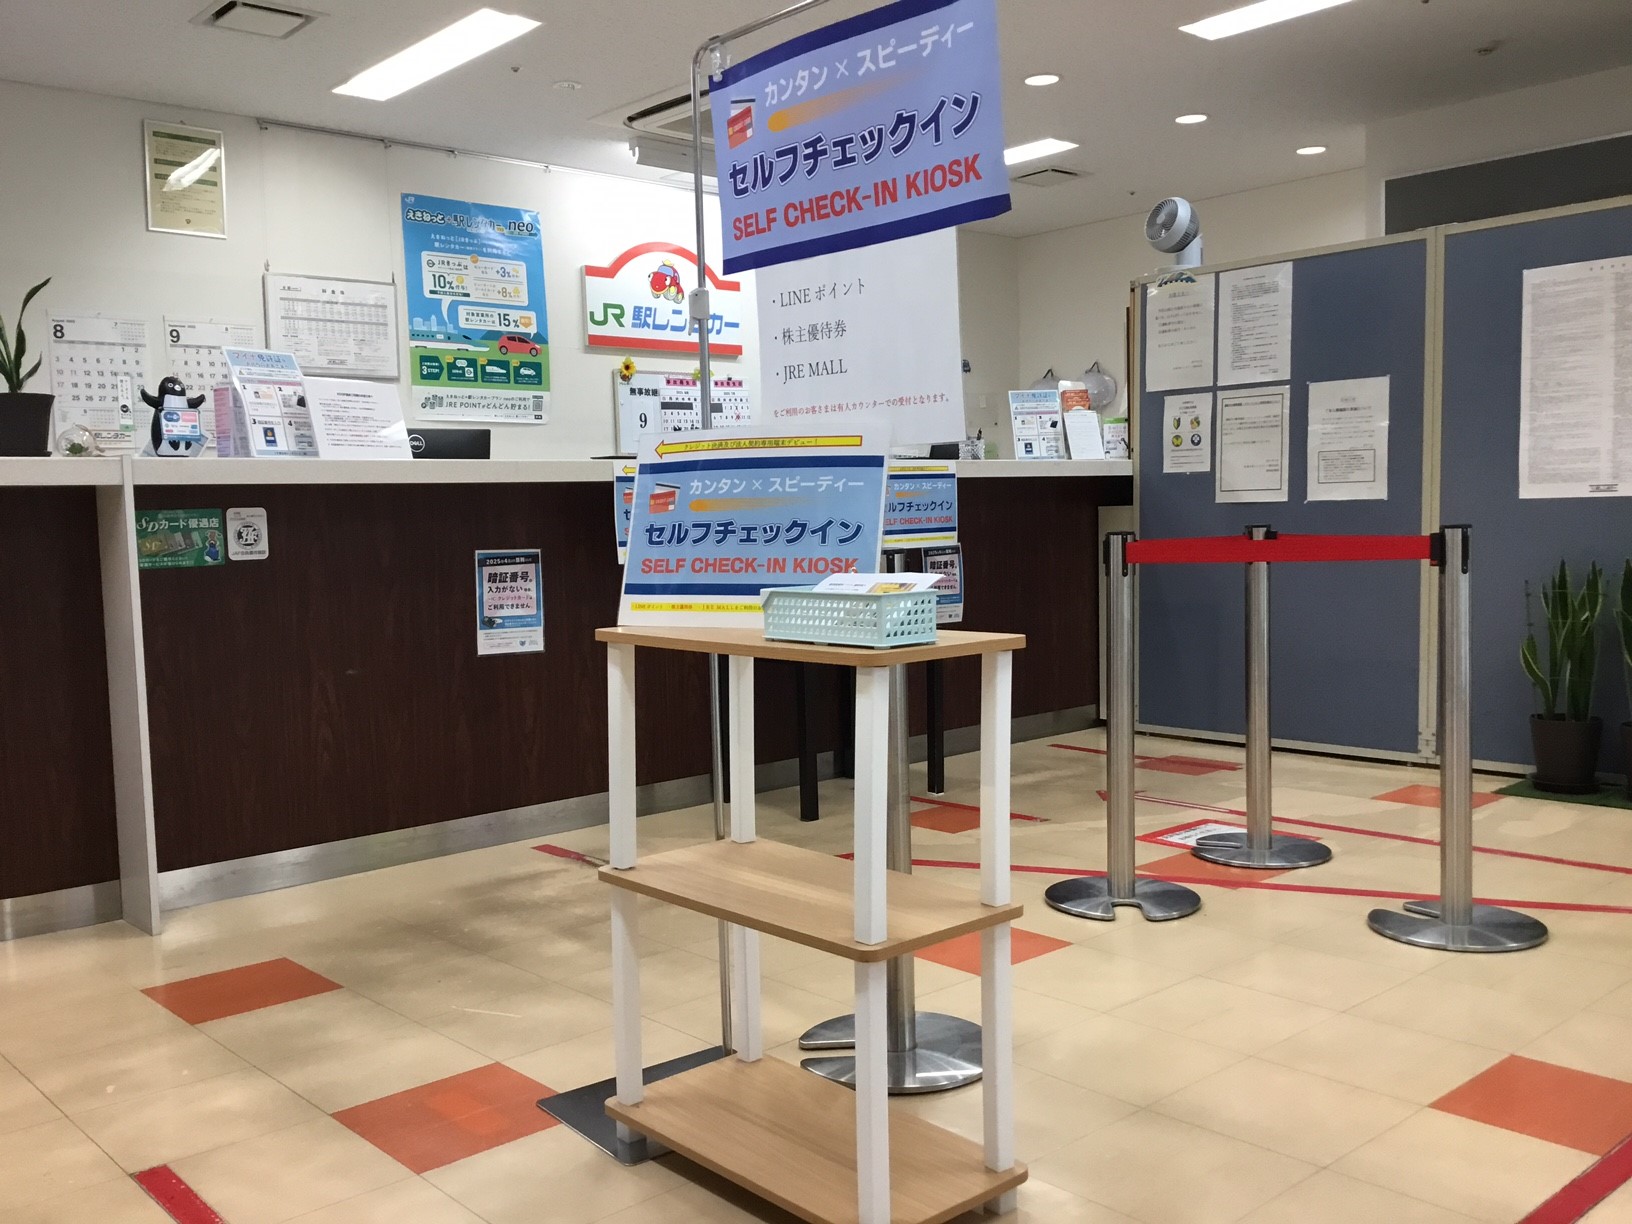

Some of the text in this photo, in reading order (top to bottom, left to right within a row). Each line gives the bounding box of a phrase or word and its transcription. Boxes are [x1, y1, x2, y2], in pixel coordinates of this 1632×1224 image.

[765, 66, 827, 106] カンタン
[856, 21, 974, 77] スピーディー
[729, 92, 980, 198] セルフチェックイン
[732, 153, 982, 240] SELF CHECK-IN KIOSK
[406, 208, 445, 224] えきねっと
[508, 220, 533, 232] neo
[432, 274, 454, 289] 10%
[815, 278, 865, 301] ポイント
[498, 313, 519, 328] 15%
[589, 302, 625, 328] JR
[53, 324, 64, 338] 8
[170, 329, 180, 343] 9
[809, 358, 848, 377] MALL
[639, 412, 647, 428] 9
[690, 479, 746, 495] カンタン
[768, 475, 864, 493] スピーディー
[922, 482, 952, 490] スピーディー
[887, 500, 952, 512] ルフチェックイン
[900, 517, 932, 525] CHECK-IN
[934, 516, 952, 524] KIOSK
[645, 519, 864, 547] セルフチェックイン
[640, 557, 858, 574] SELF CHECK-IN KIOSK
